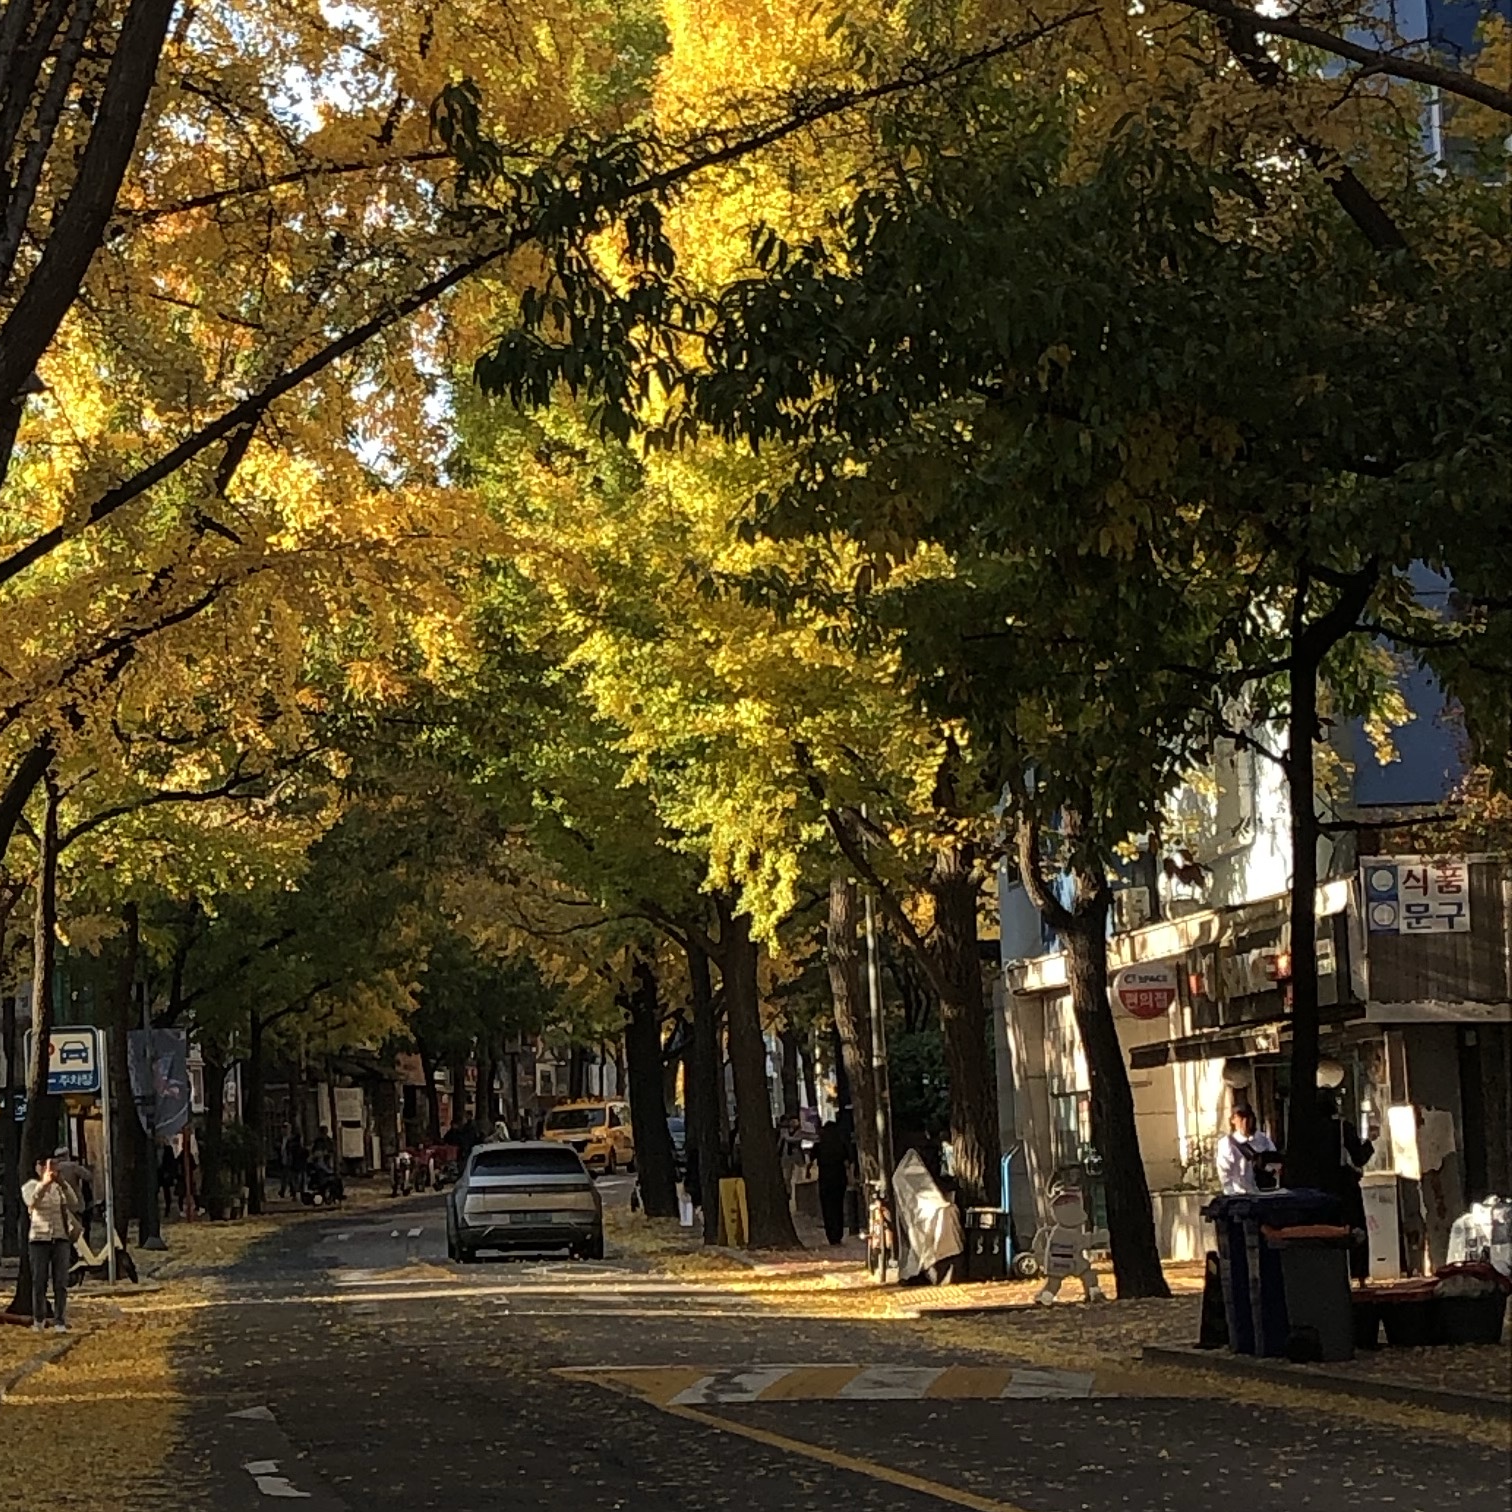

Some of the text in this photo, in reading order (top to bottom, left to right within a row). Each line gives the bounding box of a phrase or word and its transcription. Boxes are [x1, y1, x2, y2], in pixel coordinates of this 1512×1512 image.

[1402, 866, 1464, 896] 식품
[1402, 902, 1466, 929] 문구
[1125, 992, 1168, 1009] 편의점
[59, 1074, 93, 1087] 주차장
